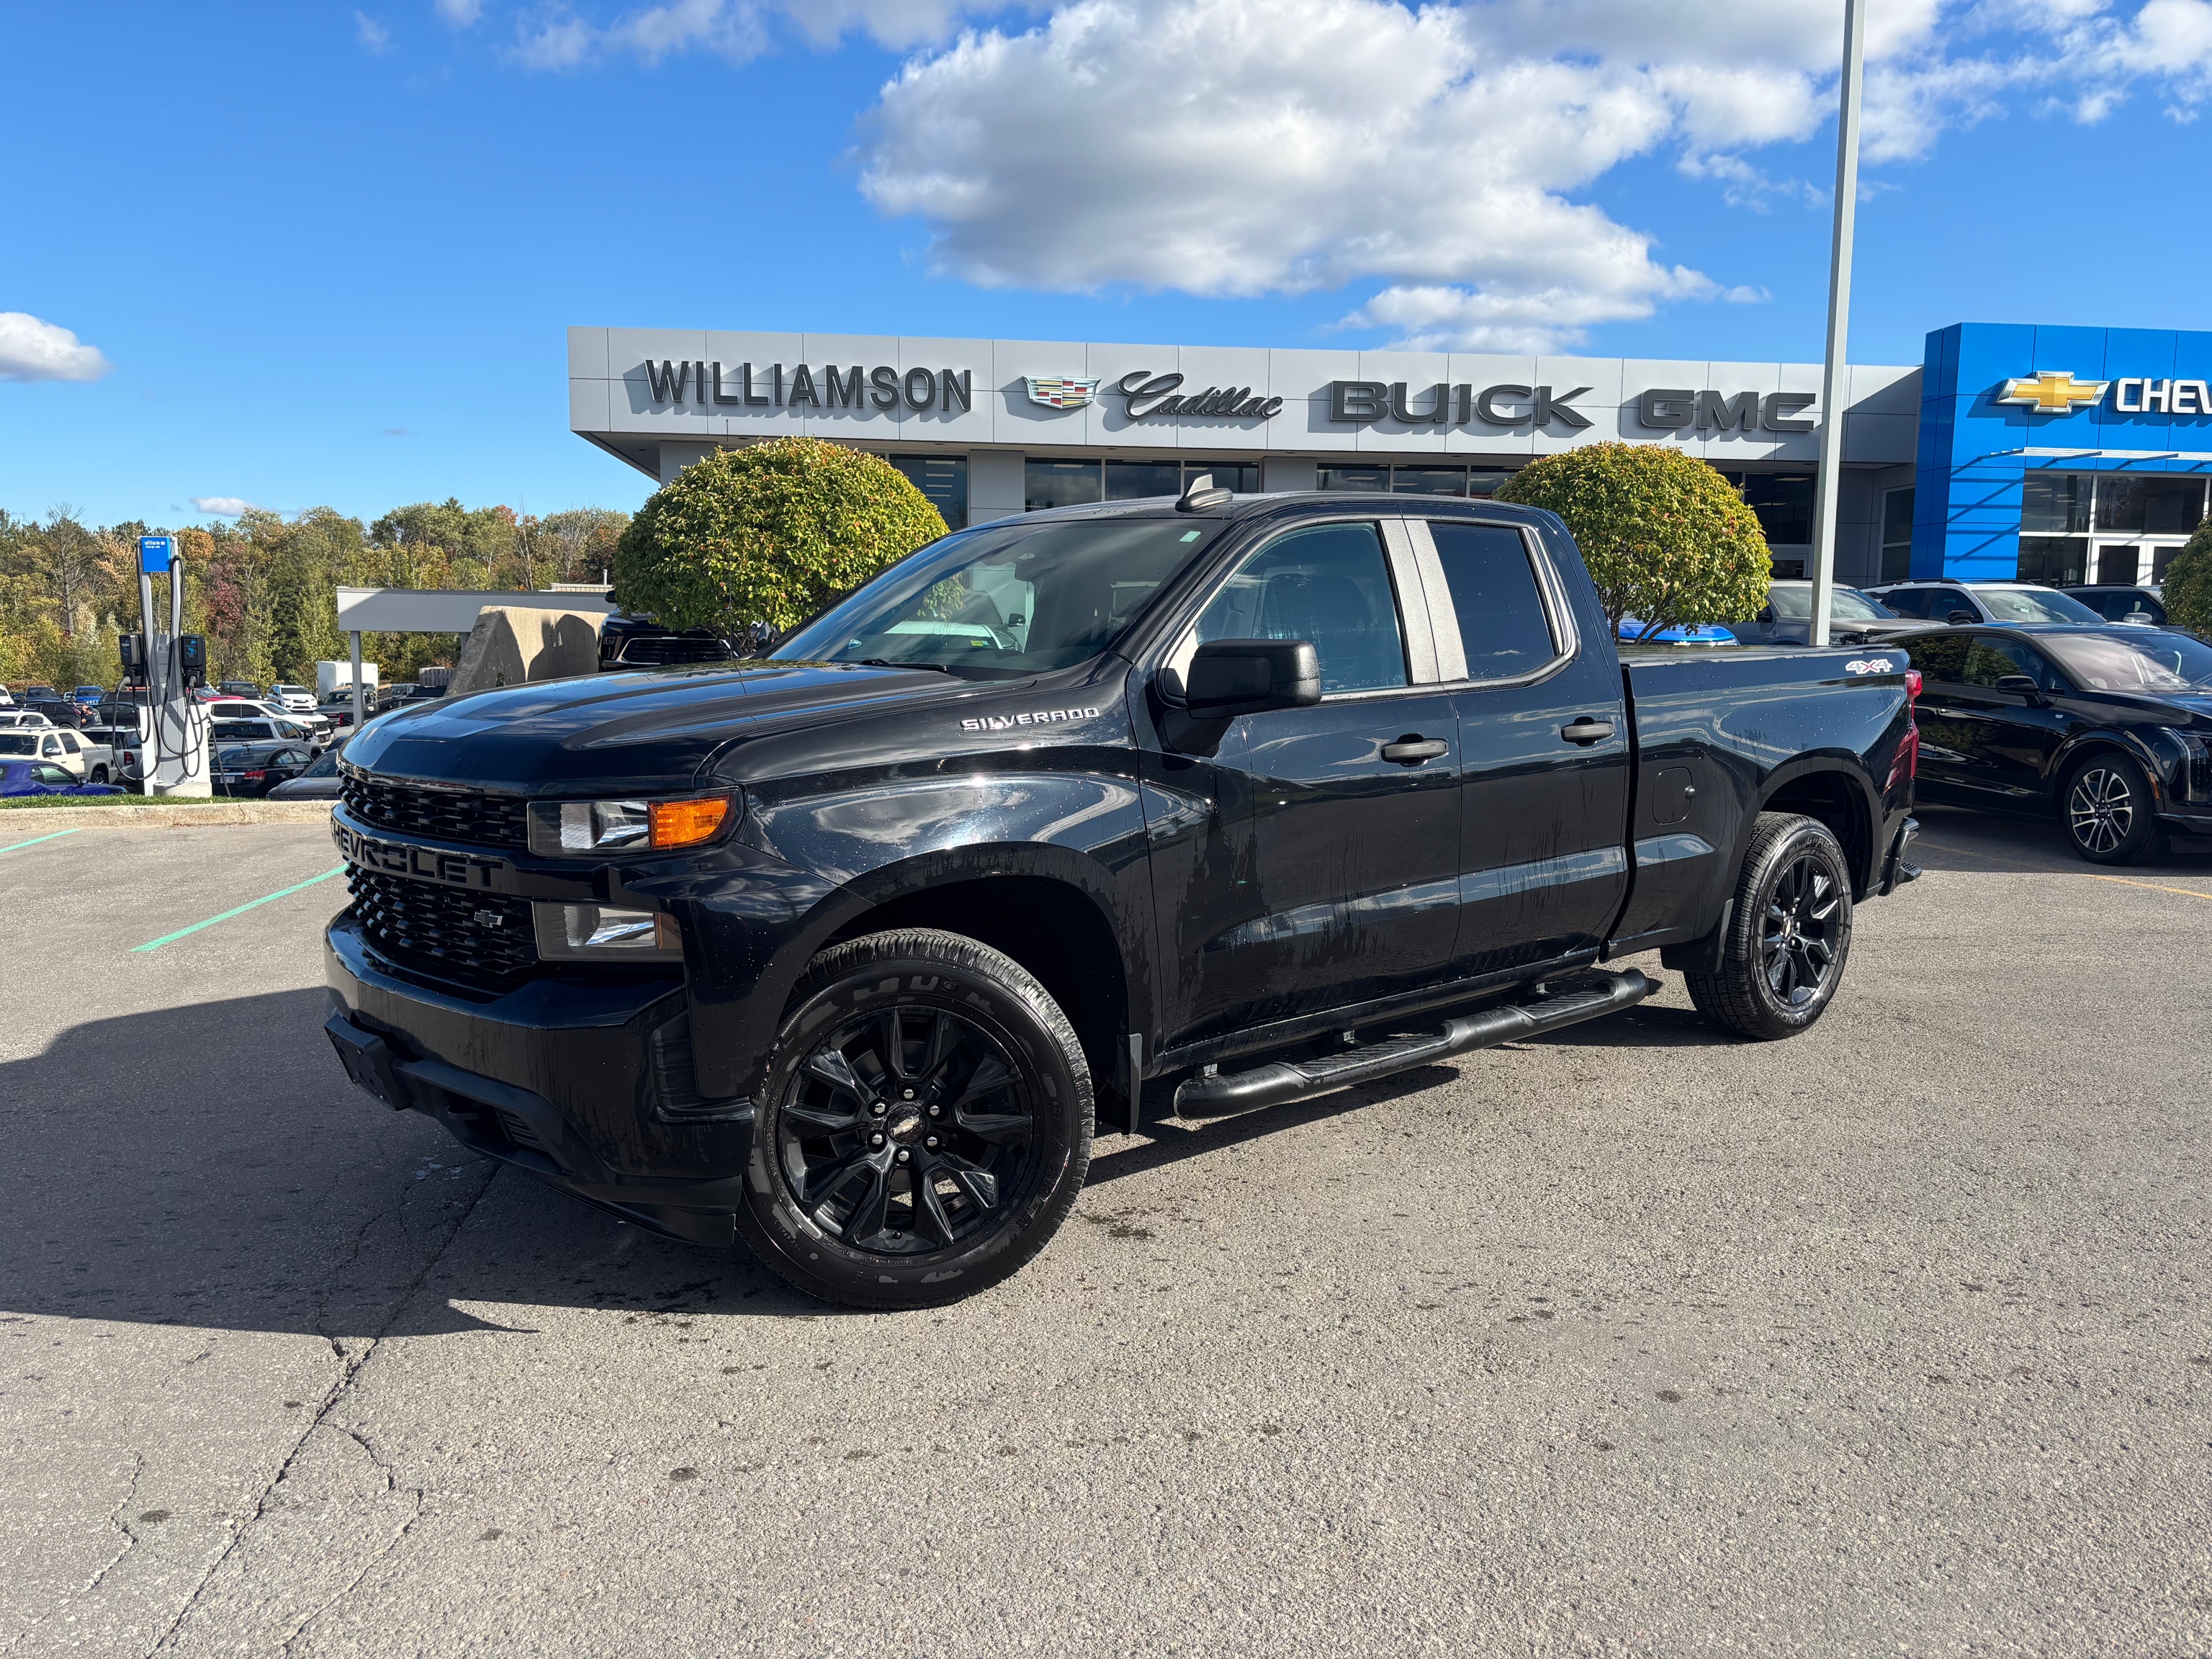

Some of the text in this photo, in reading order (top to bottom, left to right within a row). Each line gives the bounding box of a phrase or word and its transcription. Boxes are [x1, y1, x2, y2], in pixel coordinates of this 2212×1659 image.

[645, 359, 971, 411] WILLIAMSON
[1118, 371, 1283, 419] Cadillac
[1330, 380, 1595, 426] BUICK
[1641, 389, 1816, 431] GMC
[961, 707, 1099, 731] SILVERADO
